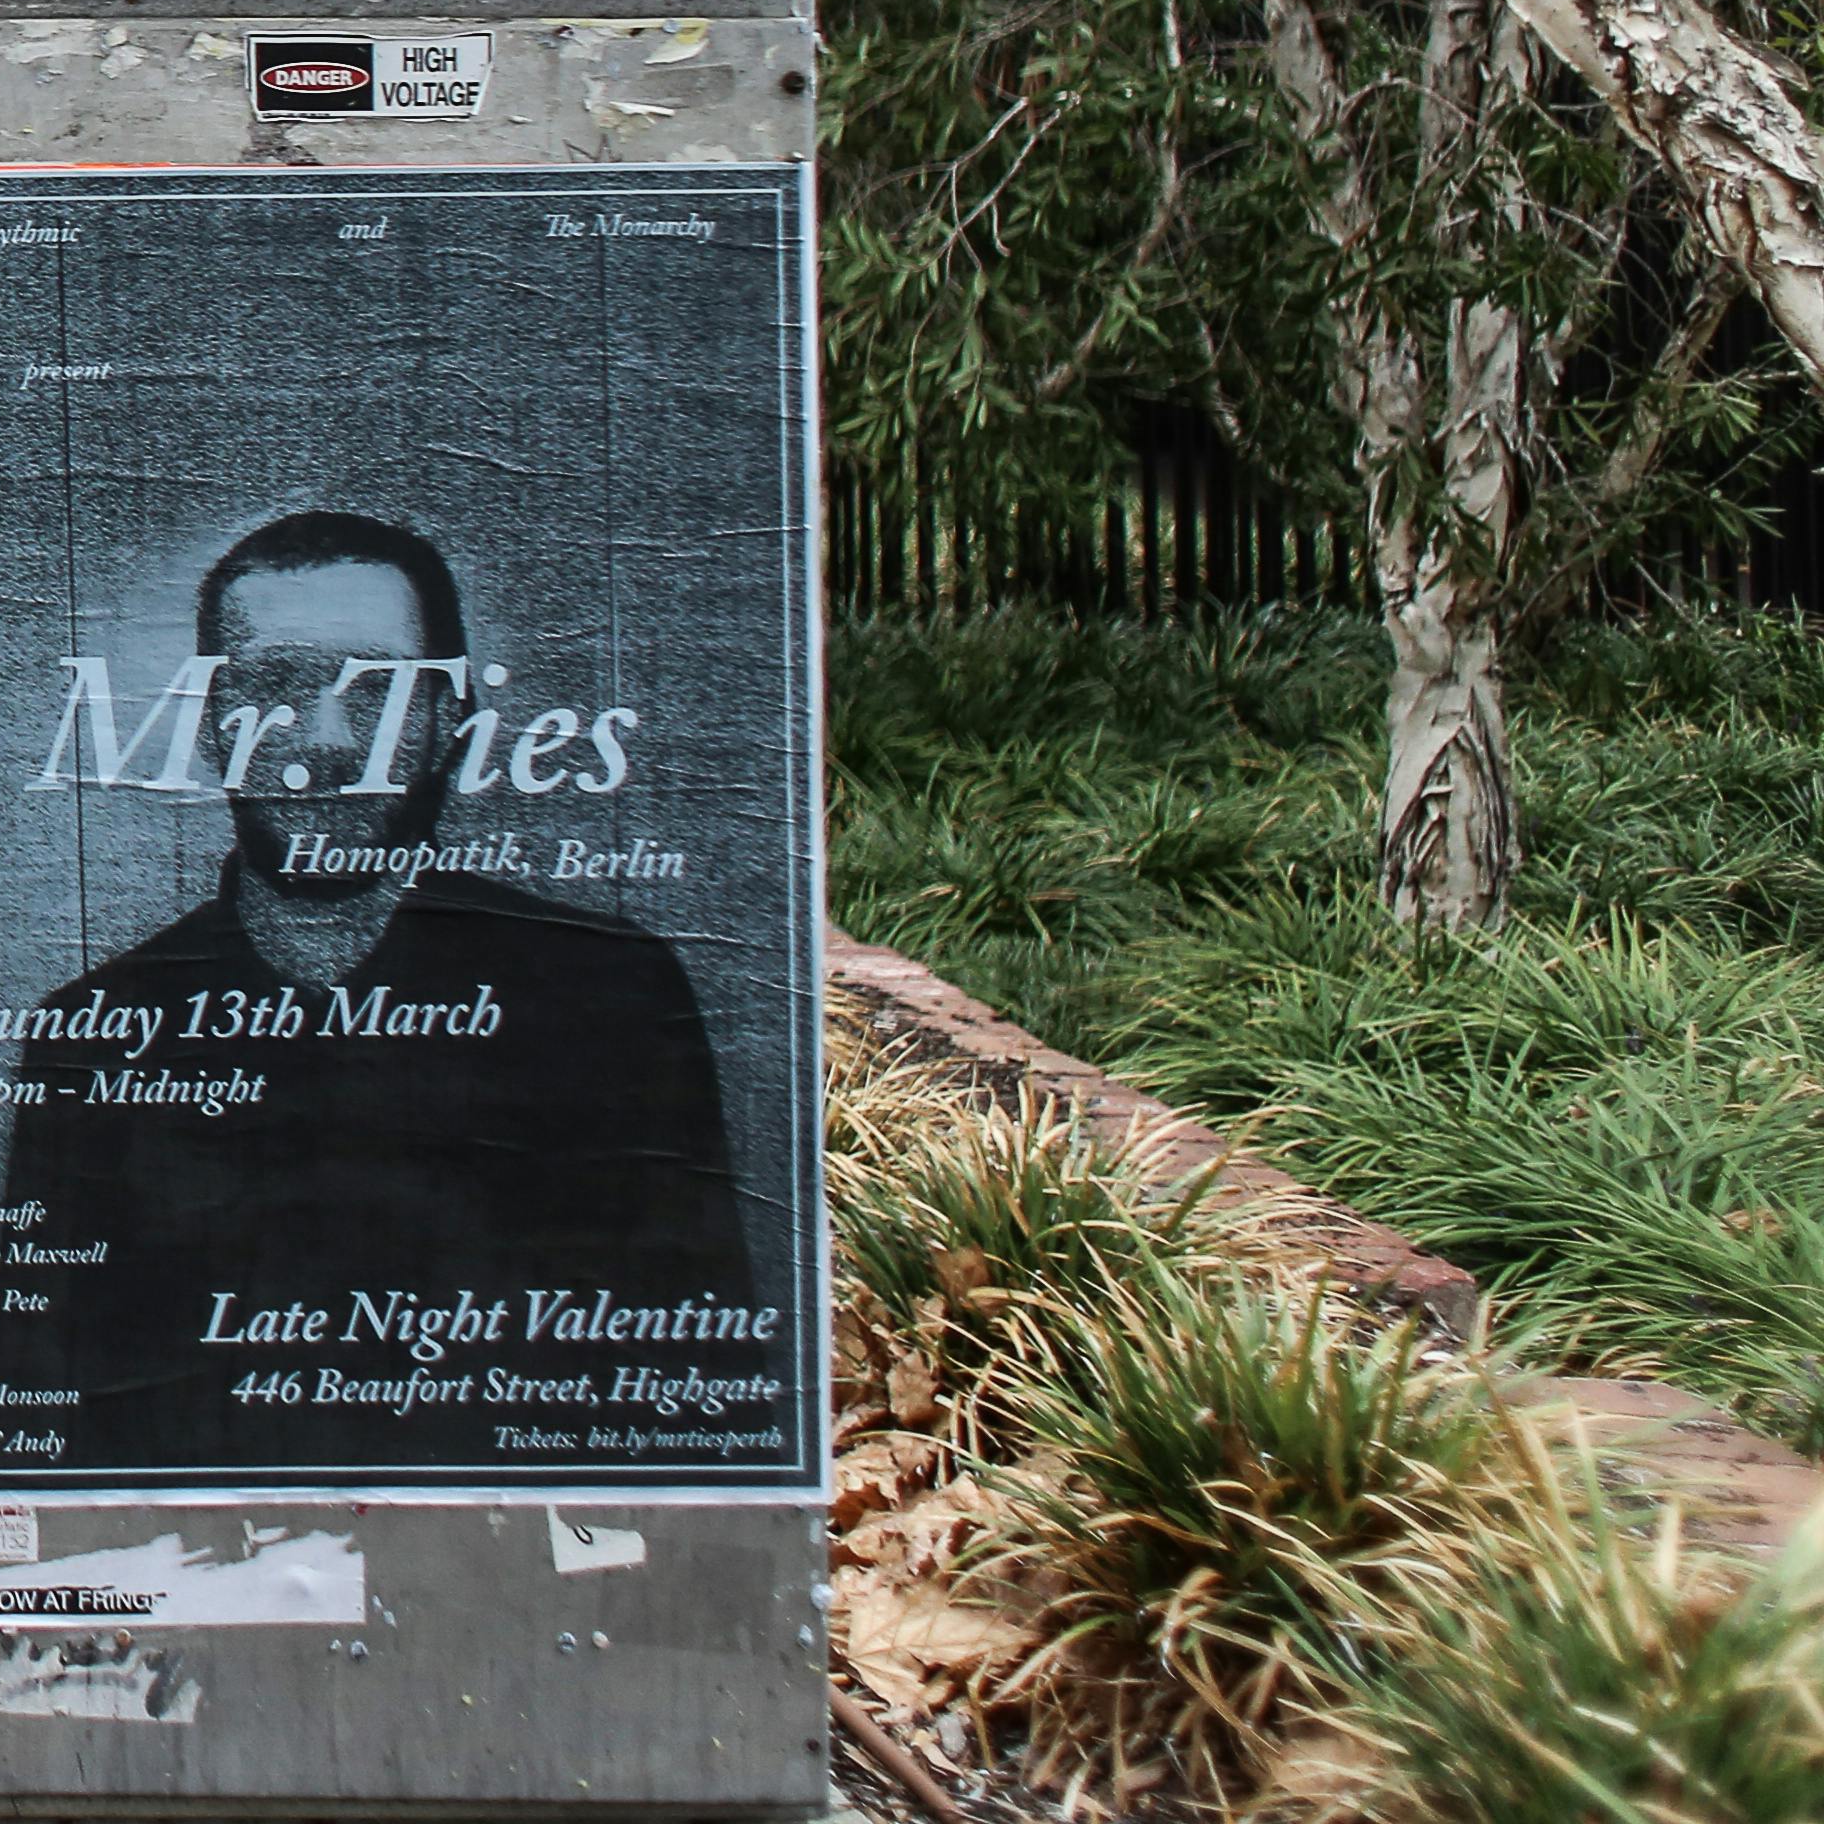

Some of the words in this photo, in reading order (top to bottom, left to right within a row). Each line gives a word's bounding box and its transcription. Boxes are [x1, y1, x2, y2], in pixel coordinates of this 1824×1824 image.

[402, 46, 458, 73] HIGH
[275, 69, 354, 87] DANGER
[381, 81, 480, 107] VOLTAGE
[337, 215, 389, 240] and
[545, 213, 585, 238] The
[590, 212, 716, 243] Monarchy
[19, 360, 113, 391] present
[330, 654, 640, 796] Ties
[279, 832, 533, 888] Homopatik,
[552, 838, 685, 880] Berlin
[177, 985, 306, 1039] 13th
[315, 984, 504, 1039] March
[83, 1067, 269, 1117] Midnight
[5, 1240, 109, 1266] Maxwell
[2, 1289, 50, 1313] Pete
[199, 1291, 329, 1344] Late
[338, 1289, 510, 1362] Night
[524, 1288, 780, 1343] Valentine
[230, 1370, 304, 1404] 446
[311, 1367, 475, 1417] Beaufort
[482, 1366, 601, 1409] Street,
[607, 1365, 782, 1416] Highgate
[2, 1429, 66, 1460] Andy
[494, 1425, 579, 1449] Tickets:
[42, 1588, 73, 1611] AT
[78, 1588, 157, 1612] FRING
